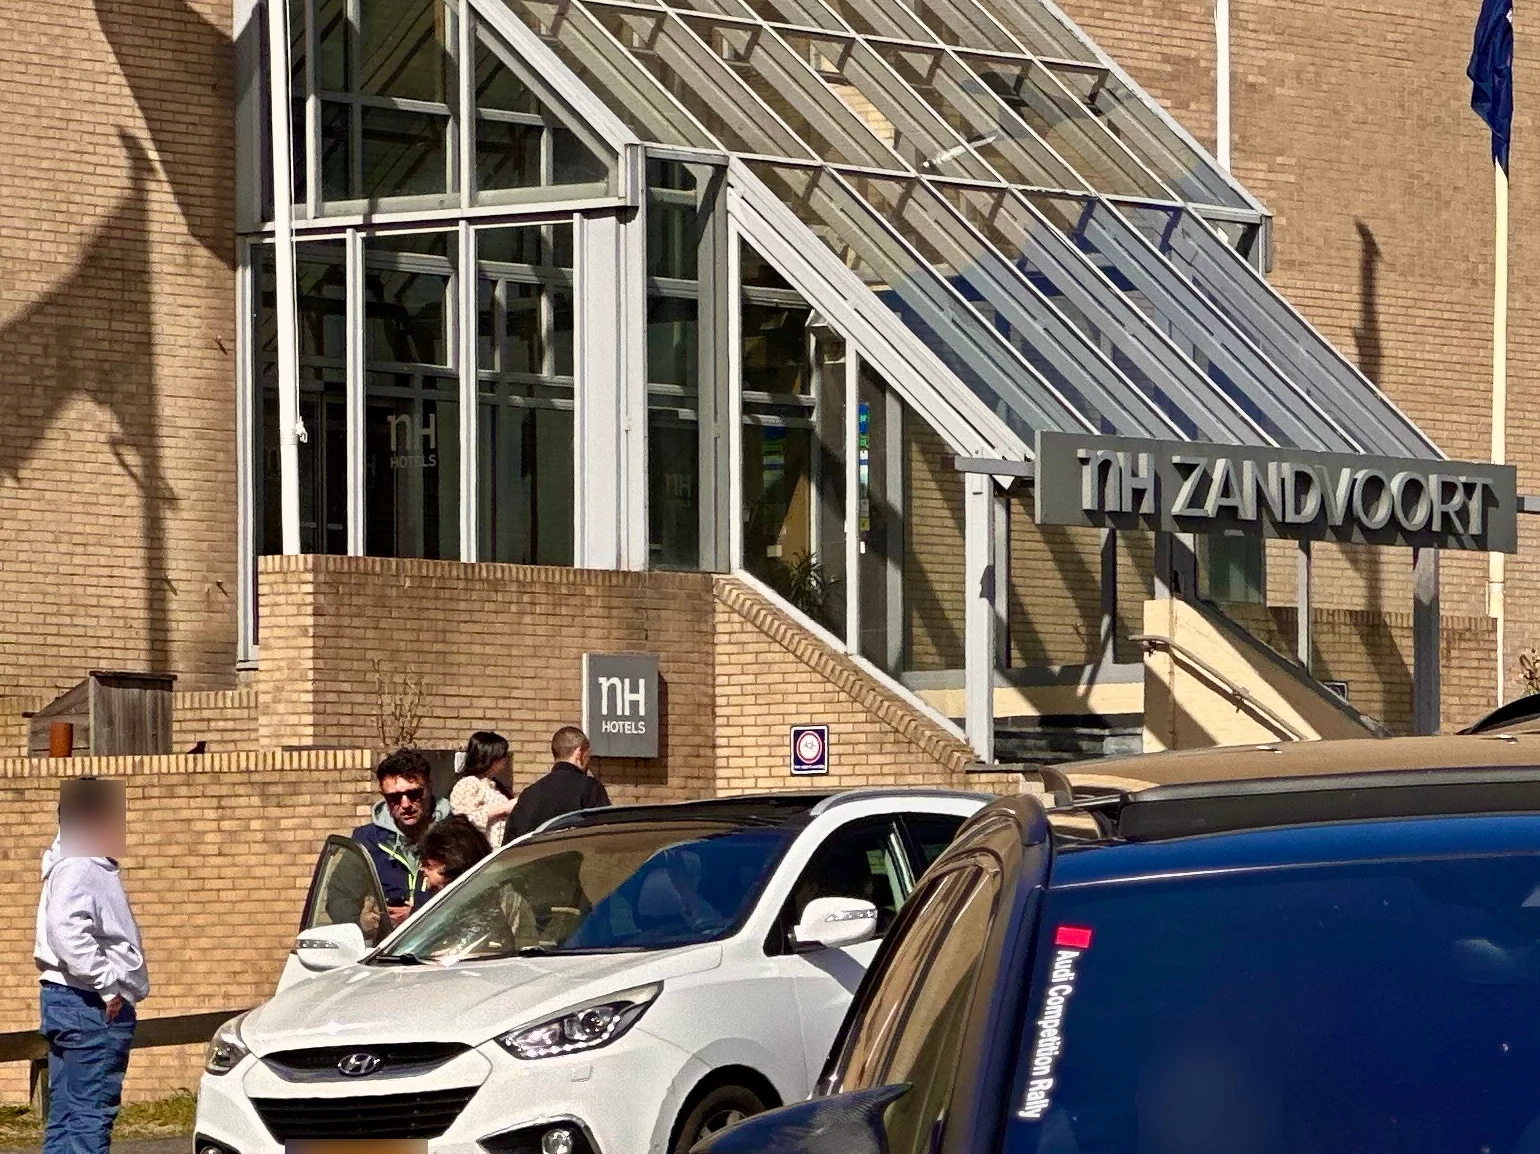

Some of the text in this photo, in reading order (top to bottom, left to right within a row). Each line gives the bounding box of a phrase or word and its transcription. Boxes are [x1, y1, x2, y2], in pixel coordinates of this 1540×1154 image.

[390, 454, 437, 469] HOTELS
[1171, 454, 1495, 536] ZANDVOORT
[601, 720, 646, 735] HOTELS
[1018, 950, 1080, 1118] Audi Competition Rally
